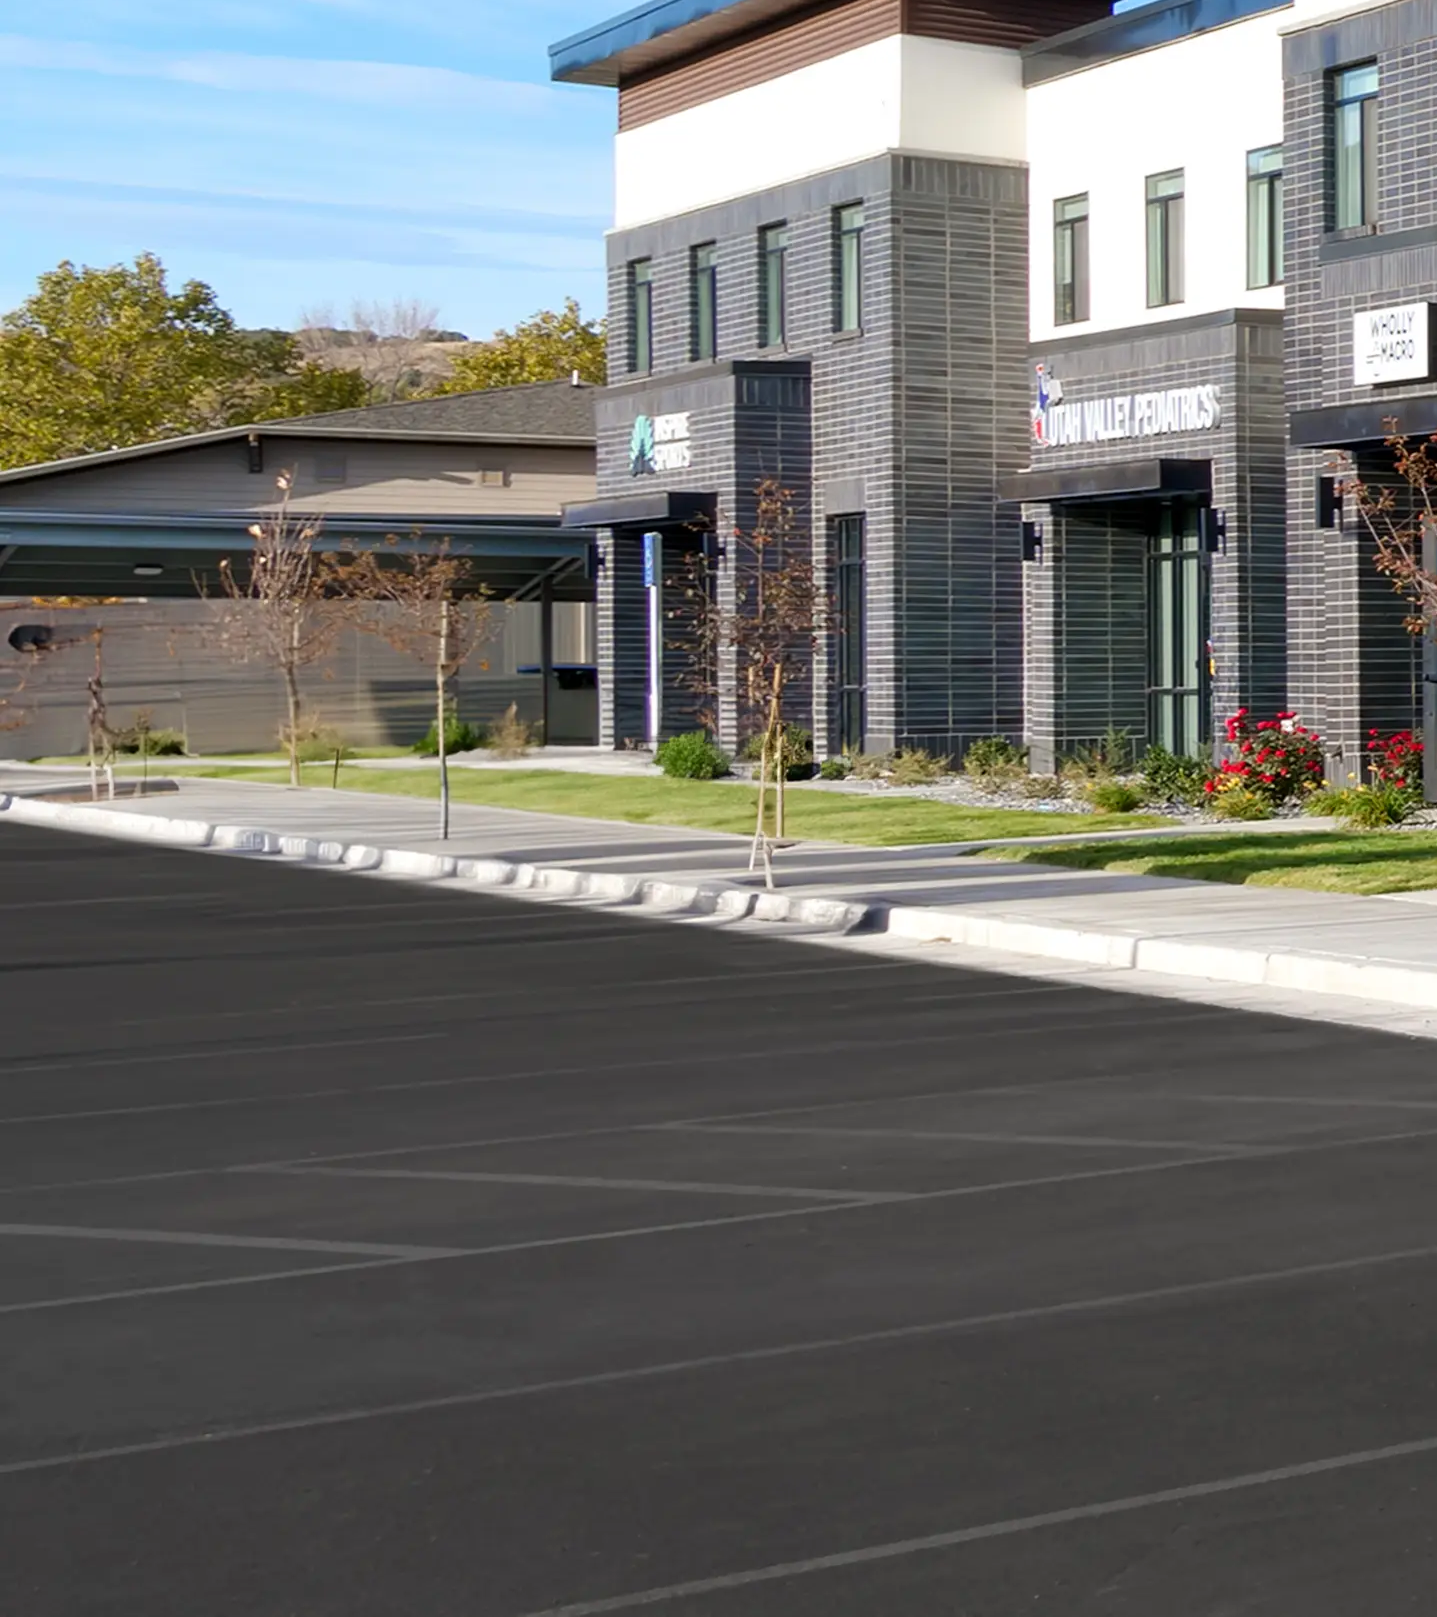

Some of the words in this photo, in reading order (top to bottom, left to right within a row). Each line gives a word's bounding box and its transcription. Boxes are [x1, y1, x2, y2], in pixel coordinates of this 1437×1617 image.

[1370, 311, 1415, 338] WHOLLY
[1381, 339, 1415, 364] MACRO
[1047, 402, 1082, 446] UTAH
[1084, 395, 1131, 441] VALLEY
[1134, 384, 1217, 437] PEDIATRICS
